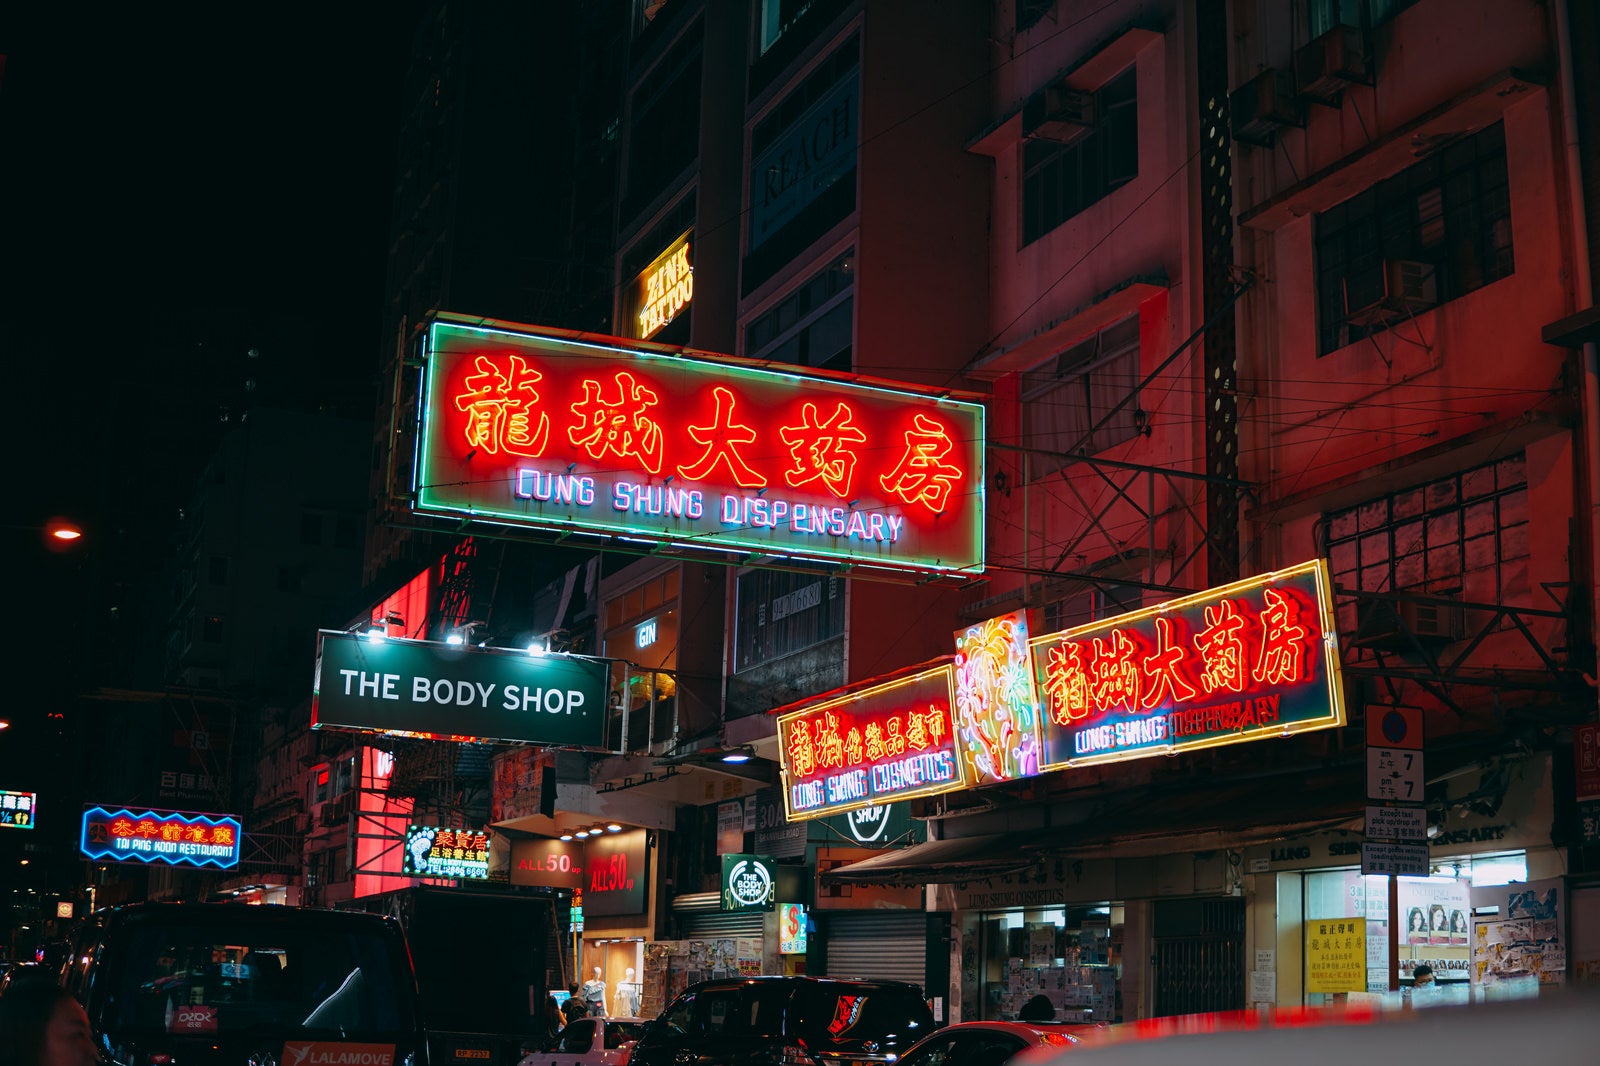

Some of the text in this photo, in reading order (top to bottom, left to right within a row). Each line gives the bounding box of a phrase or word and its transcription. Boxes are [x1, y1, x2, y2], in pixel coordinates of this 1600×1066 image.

[647, 242, 690, 306] ZINK
[640, 273, 693, 339] TATTOO
[515, 468, 903, 543] LUNG SHING DISPENSARY
[639, 622, 656, 648] GIN
[339, 669, 400, 701] THE
[412, 676, 496, 708] BODY
[1075, 693, 1281, 754] LUNG SHING DISPENSARY
[1378, 760, 1395, 769] 上午
[1403, 754, 1413, 771] 7
[792, 750, 954, 810] LUNG SHING COSMETICS
[1381, 778, 1392, 786] pm
[1403, 780, 1414, 797] 7
[1378, 787, 1396, 797] 下午
[856, 805, 884, 824] SHOP
[1371, 817, 1385, 825] pick
[1379, 809, 1400, 818] Except
[115, 837, 233, 858] TAI PING KOON RESTAURANT
[1271, 846, 1310, 862] LUNG
[1329, 842, 1362, 857] SHIN
[1365, 845, 1386, 853] Except
[517, 858, 545, 871] ALL
[545, 853, 571, 873] 50
[590, 870, 608, 892] ALL
[609, 852, 627, 891] 50
[737, 881, 762, 889] BODY
[742, 873, 758, 881] THE
[739, 888, 762, 897] SHOP
[968, 887, 1064, 908] LUNG SHING COSMETICS
[309, 1052, 391, 1065] LALAMOVE
